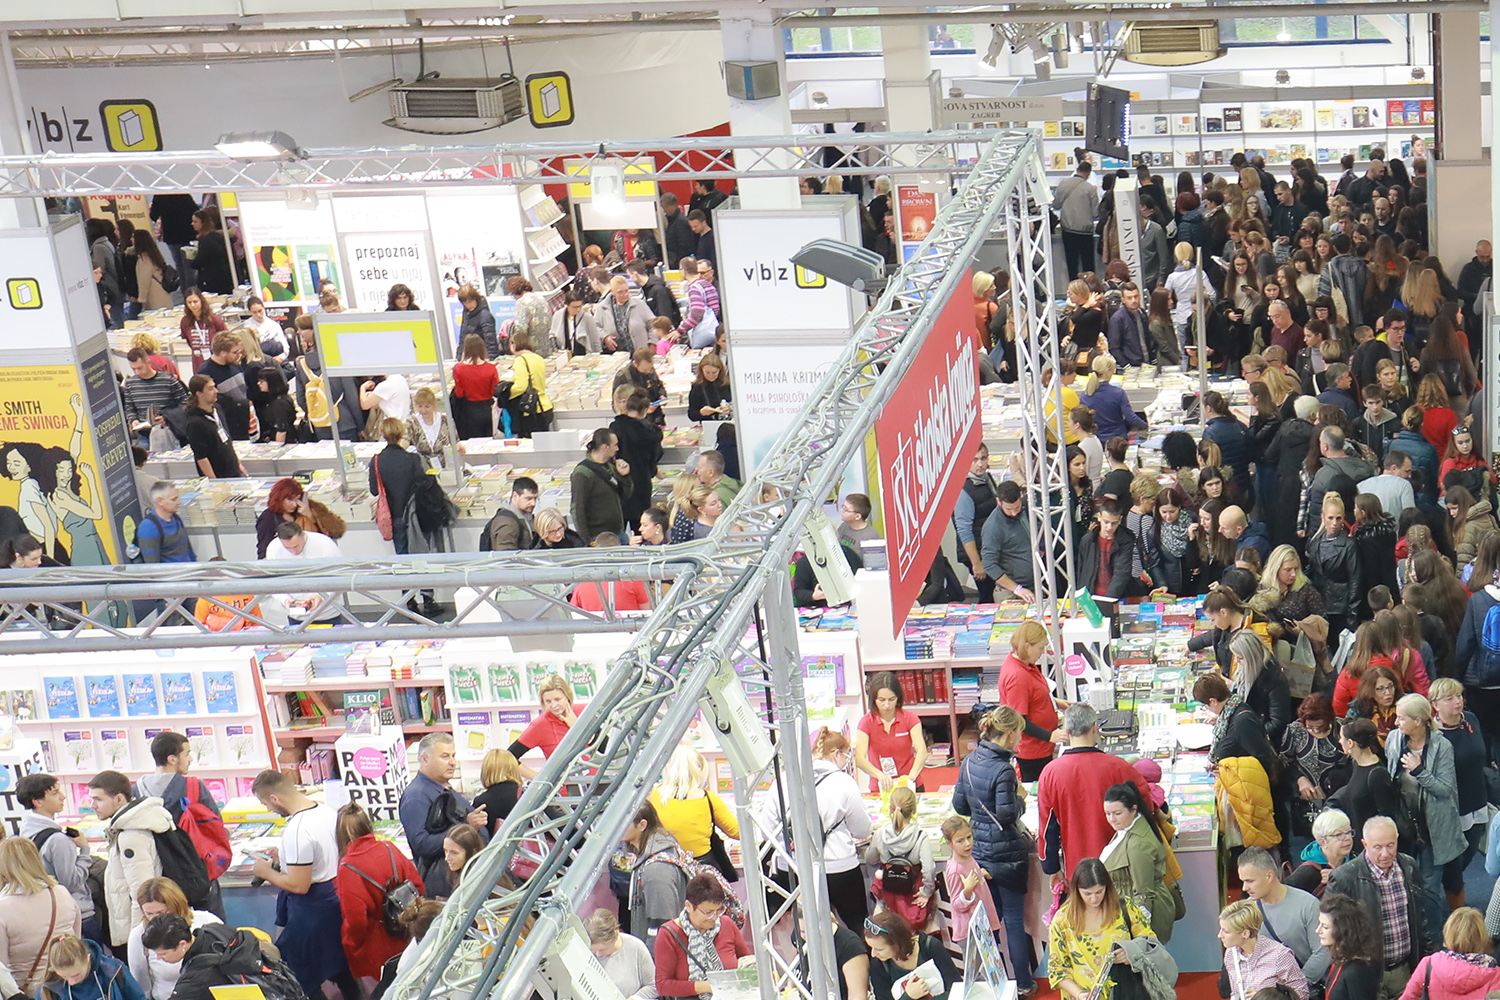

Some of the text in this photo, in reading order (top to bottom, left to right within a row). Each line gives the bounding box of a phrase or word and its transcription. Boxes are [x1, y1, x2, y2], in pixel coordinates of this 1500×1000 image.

[944, 103, 967, 111] OVA
[969, 101, 1027, 111] STVARNOST
[907, 190, 926, 198] DAN
[902, 197, 933, 206] BROWN
[120, 212, 146, 220] Vonnegut
[356, 244, 420, 261] prepoznaj
[443, 252, 470, 262] ALPHA
[360, 266, 389, 280] sebe
[744, 371, 788, 384] MIRJANA
[746, 394, 764, 404] MALA
[4, 400, 42, 416] SMITH
[23, 414, 70, 430] SWINGA
[914, 331, 976, 513] školska knjiga
[347, 694, 377, 704] KLIO
